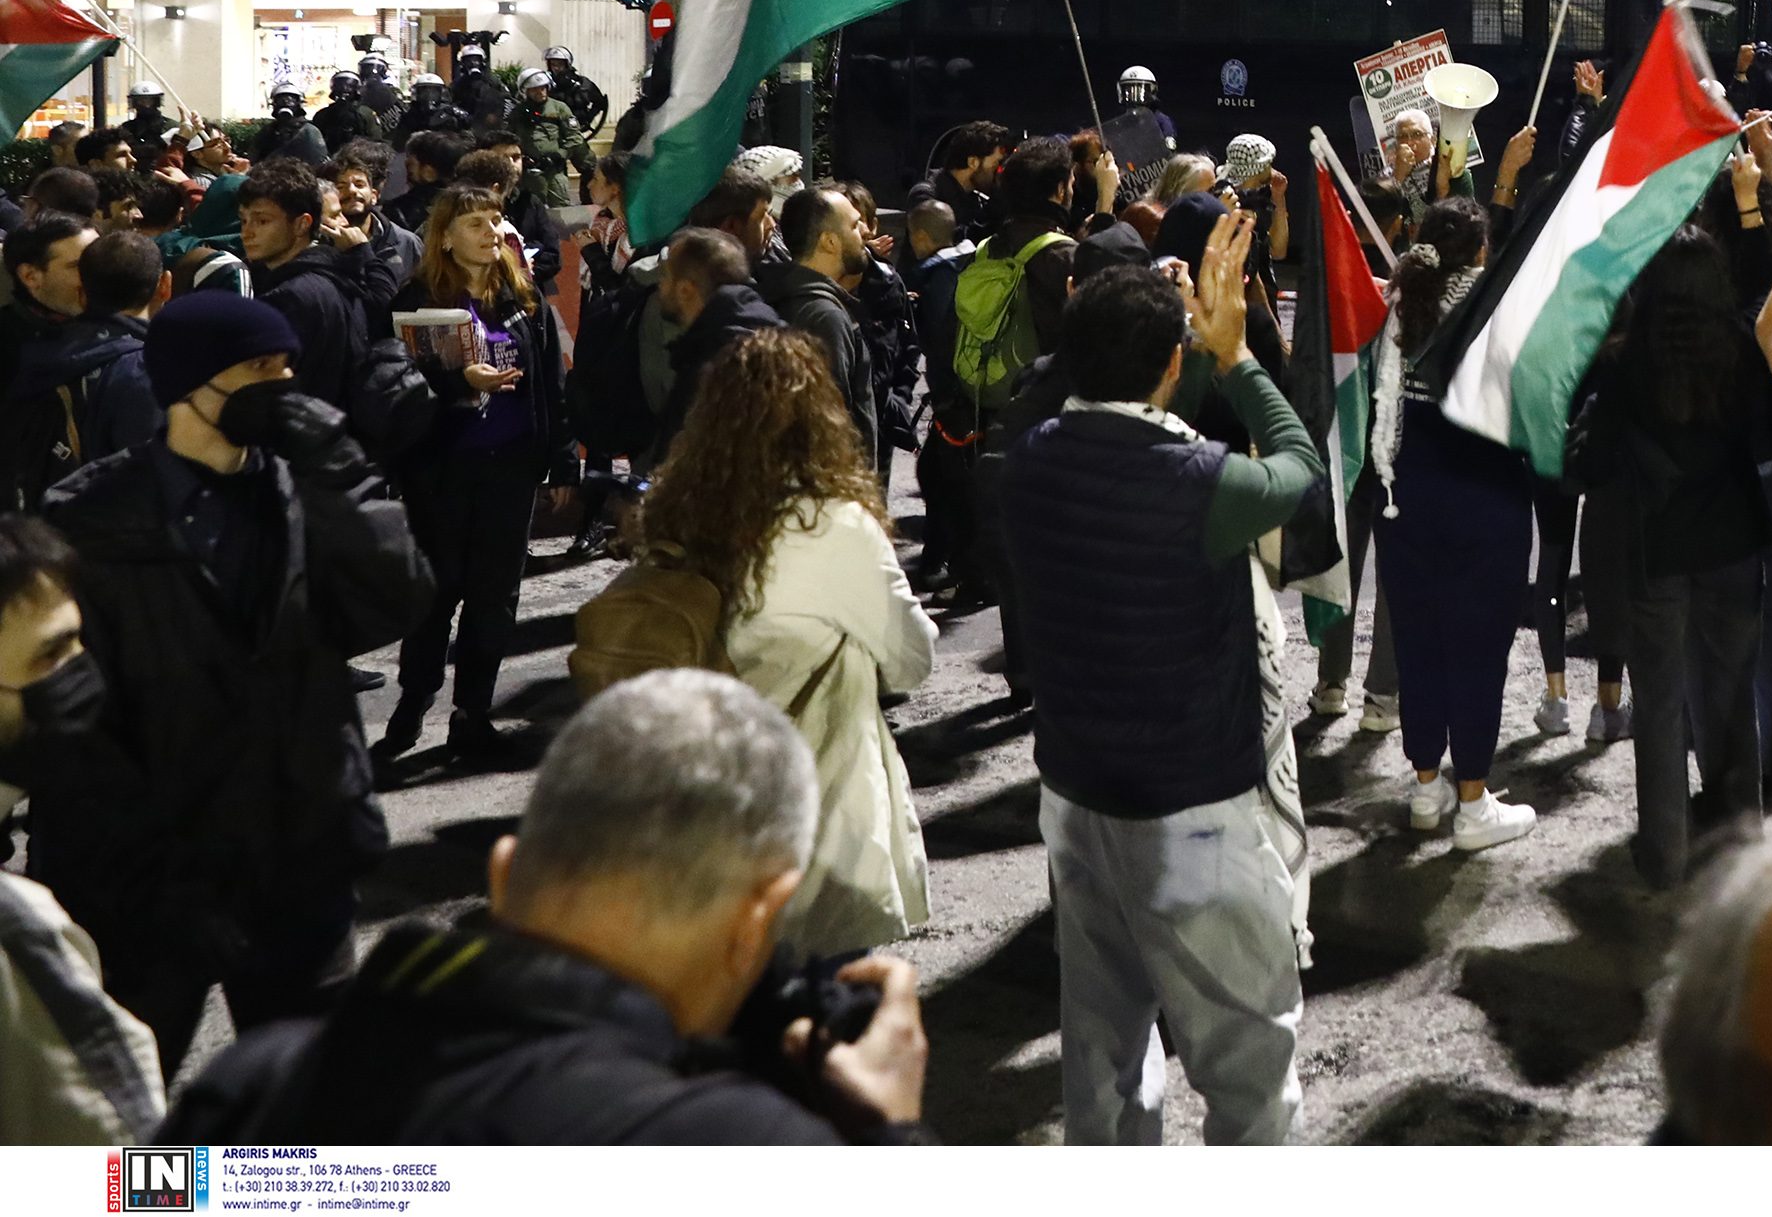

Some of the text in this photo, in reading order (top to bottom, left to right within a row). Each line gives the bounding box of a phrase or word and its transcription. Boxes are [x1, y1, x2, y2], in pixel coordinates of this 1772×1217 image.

[1394, 50, 1448, 82] ΑΠΕΡΓΙΑ
[1368, 70, 1384, 86] 10
[1217, 98, 1256, 107] POLICE
[1120, 158, 1169, 191] ΥΝΟΜΙΑ
[495, 349, 519, 358] RIVER
